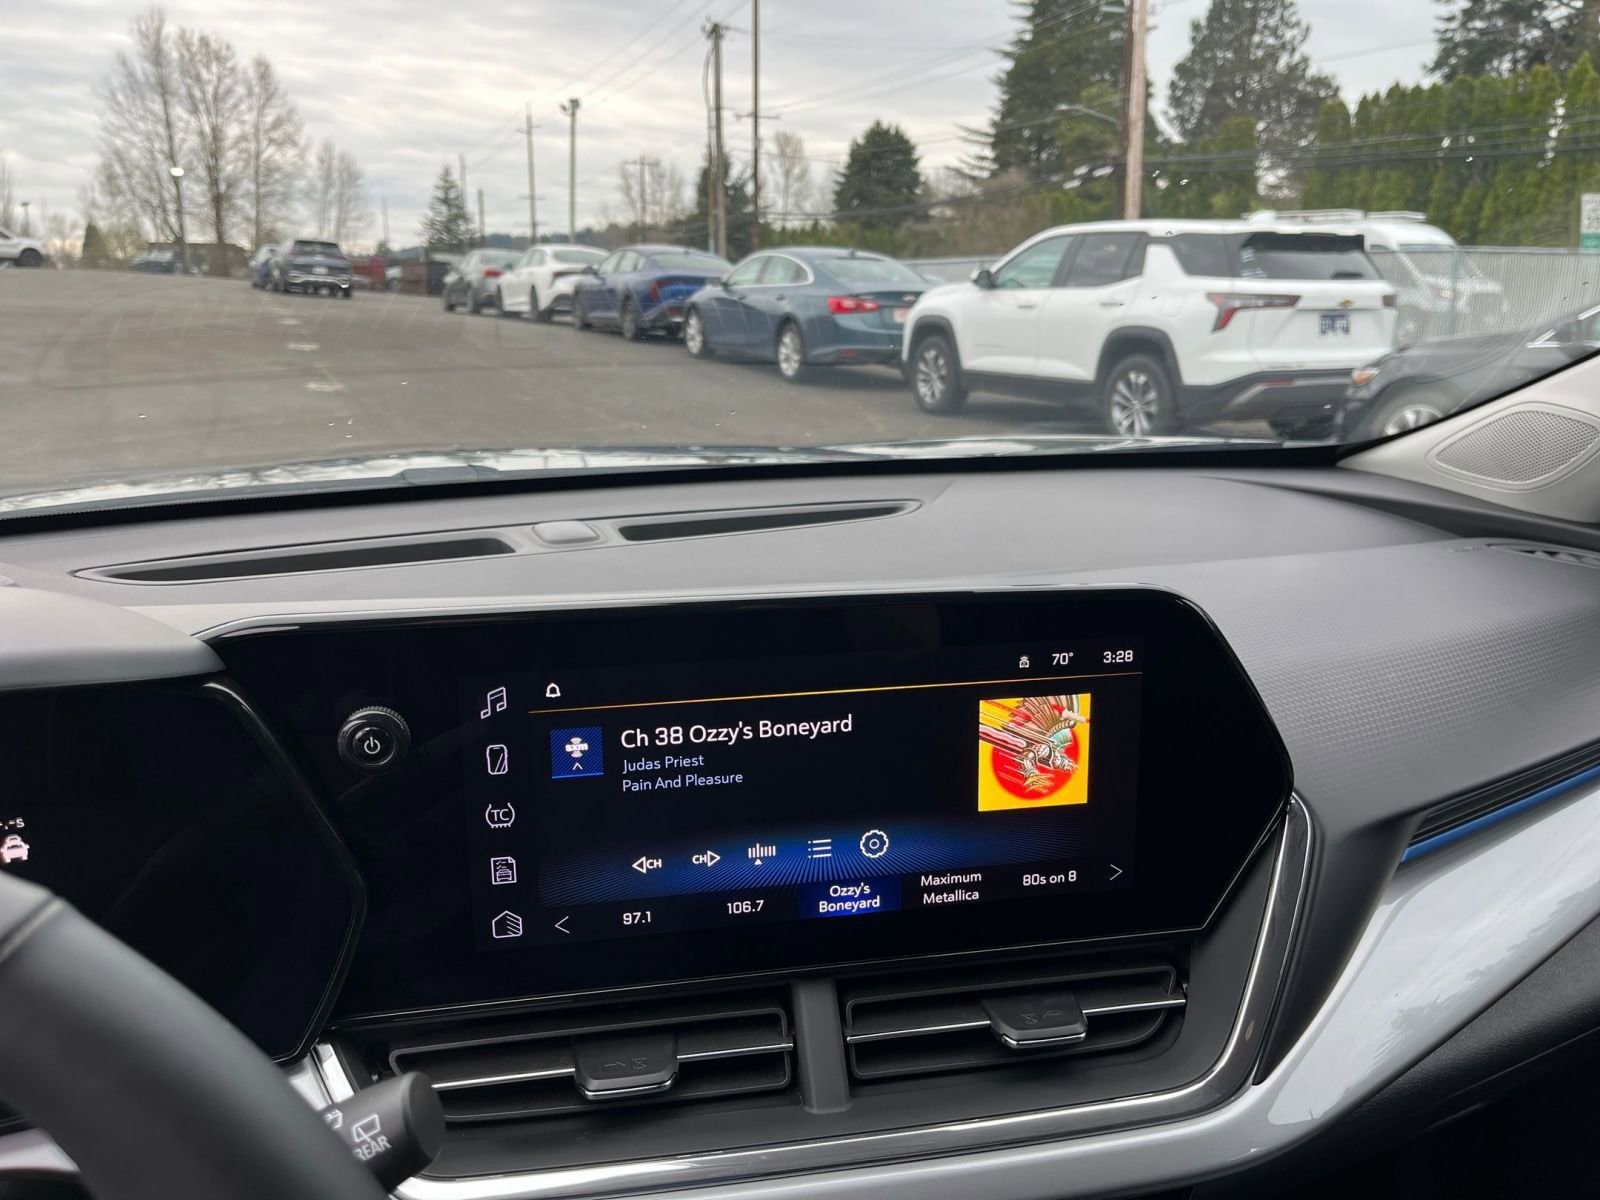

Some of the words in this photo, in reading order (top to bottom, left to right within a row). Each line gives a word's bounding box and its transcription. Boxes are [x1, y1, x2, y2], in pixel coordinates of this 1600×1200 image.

[1103, 649, 1134, 664] 3:28
[620, 728, 649, 749] Ch
[655, 726, 684, 746] 38
[689, 720, 754, 746] Ozzy's
[759, 713, 852, 740] Boneyard
[622, 758, 661, 774] Judas
[665, 754, 705, 769] Priest
[622, 778, 652, 792] Pain
[654, 775, 682, 790] And
[685, 771, 744, 787] Pleasure
[491, 808, 511, 822] TC
[647, 858, 662, 870] CH
[690, 854, 706, 865] CH
[920, 871, 982, 888] Maximum
[1022, 873, 1047, 886] 80s
[1049, 874, 1065, 884] on
[1068, 870, 1077, 883] 8
[829, 882, 871, 898] Ozzy's
[922, 888, 980, 905] Metallica
[726, 899, 764, 915] 106.7
[818, 896, 881, 914] Boneyard
[622, 911, 652, 925] 97.1
